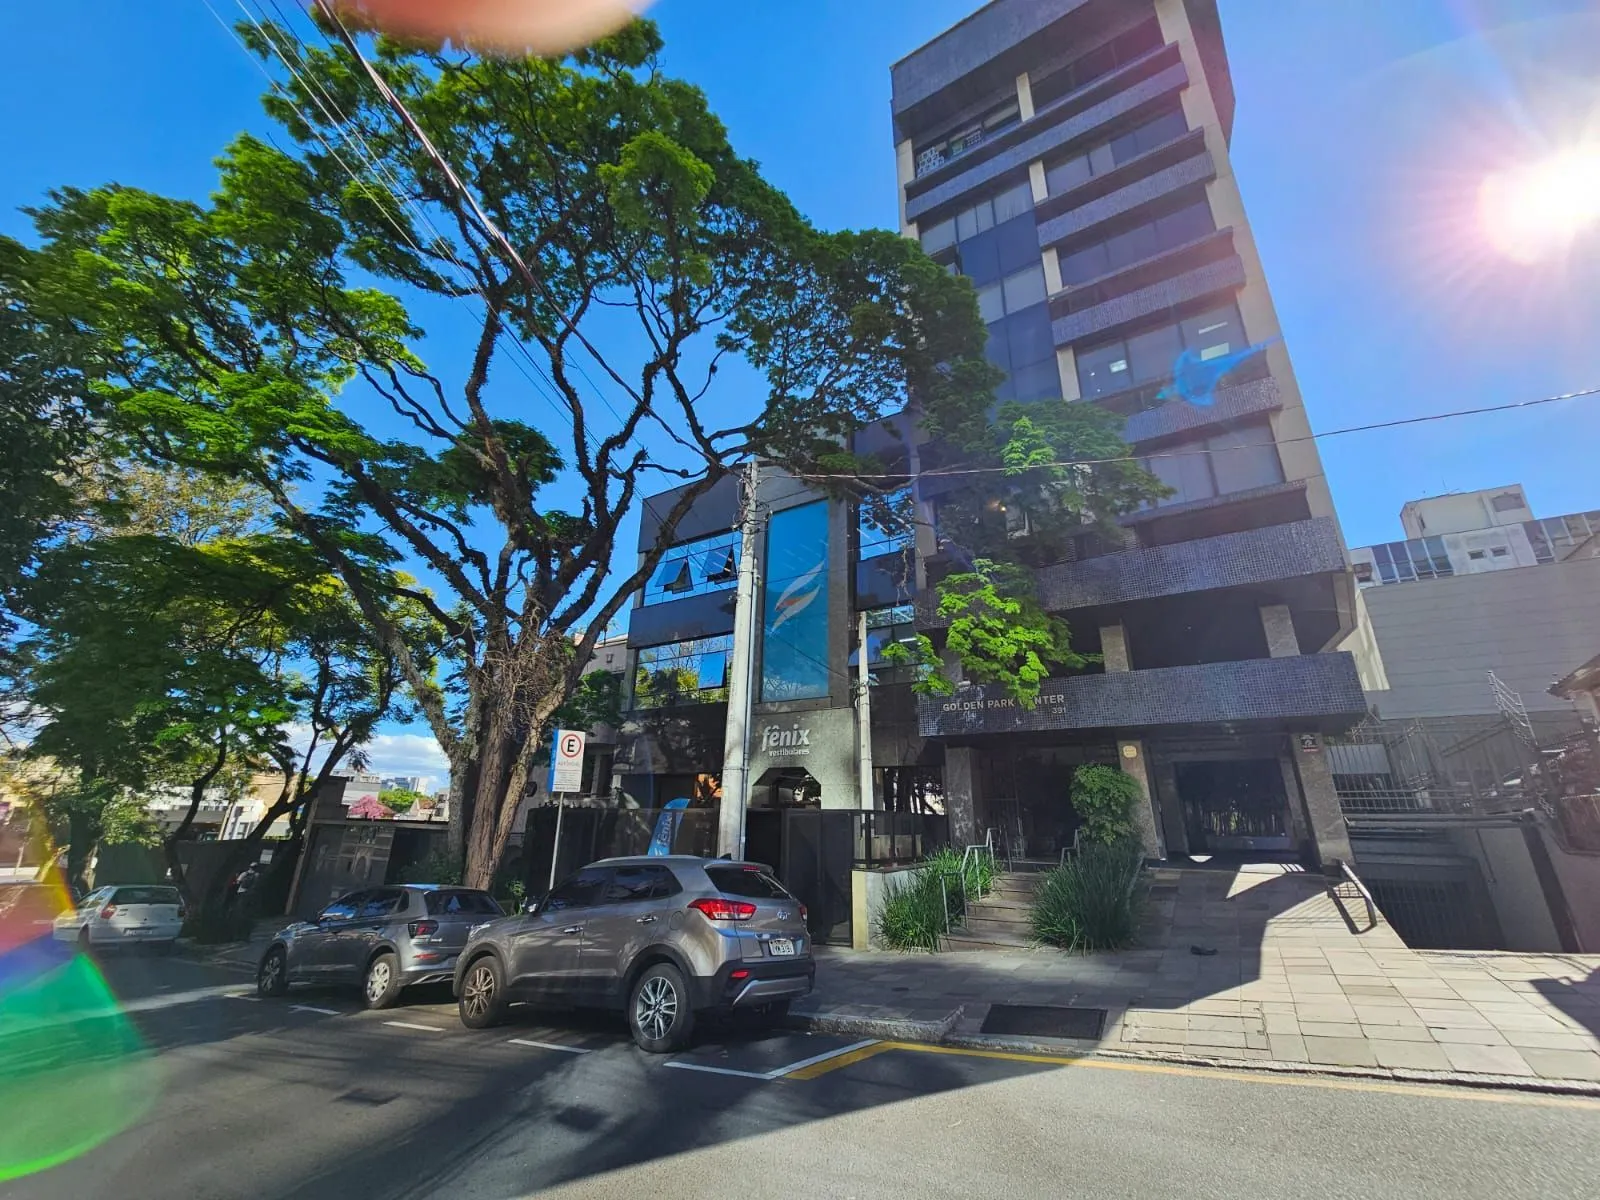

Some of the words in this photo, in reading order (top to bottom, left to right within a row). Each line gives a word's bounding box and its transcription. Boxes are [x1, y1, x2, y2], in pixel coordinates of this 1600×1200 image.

[942, 700, 984, 712] GOLDEN
[987, 698, 1015, 709] PARK
[1019, 694, 1065, 706] NTER
[1051, 706, 1066, 714] 391
[761, 723, 810, 752] fênix
[567, 739, 576, 753] E
